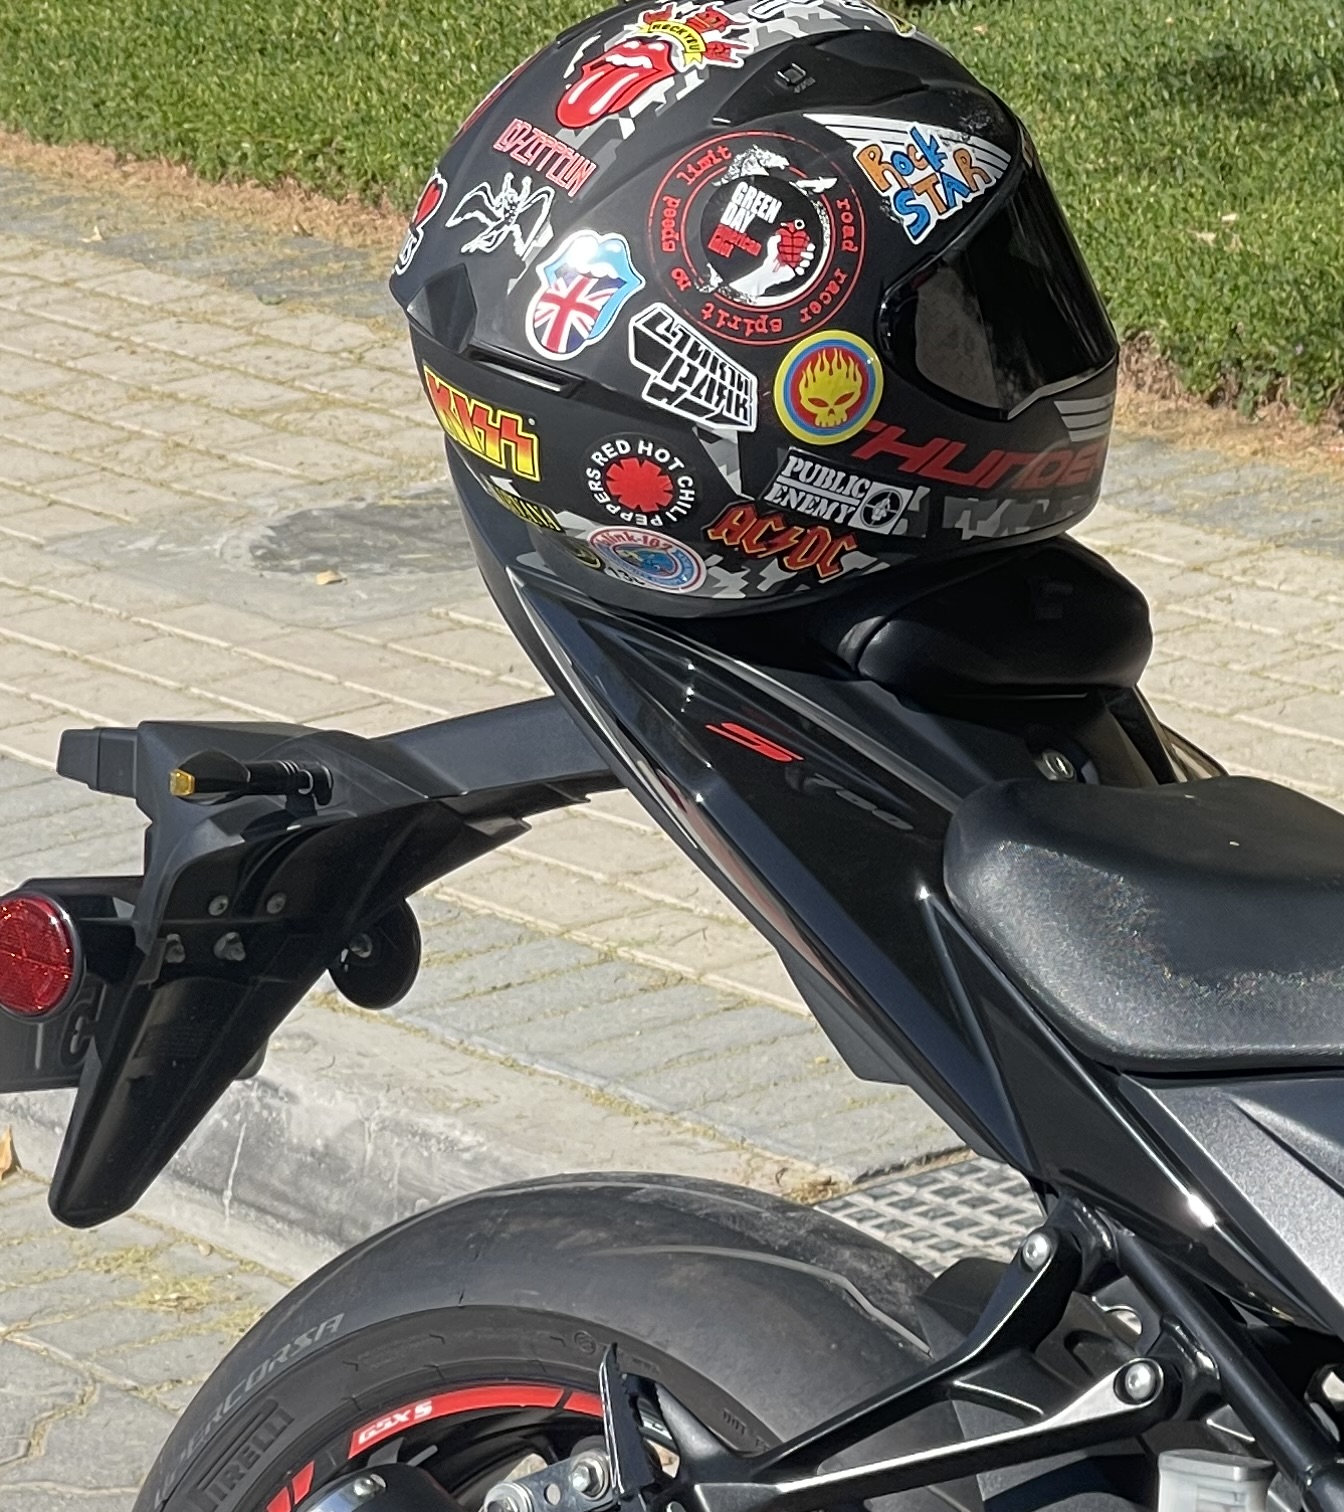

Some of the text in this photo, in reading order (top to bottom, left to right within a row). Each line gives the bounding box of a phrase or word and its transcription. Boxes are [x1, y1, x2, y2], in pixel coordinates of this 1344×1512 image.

[720, 202, 757, 233] DAY
[731, 182, 782, 223] GREEN
[424, 365, 540, 482] KISS
[586, 439, 695, 527] RED HOT CHILI PEPPERS
[782, 455, 868, 498] PUBLIC
[764, 486, 858, 526] ENEMY
[358, 1400, 433, 1444] GSX S
